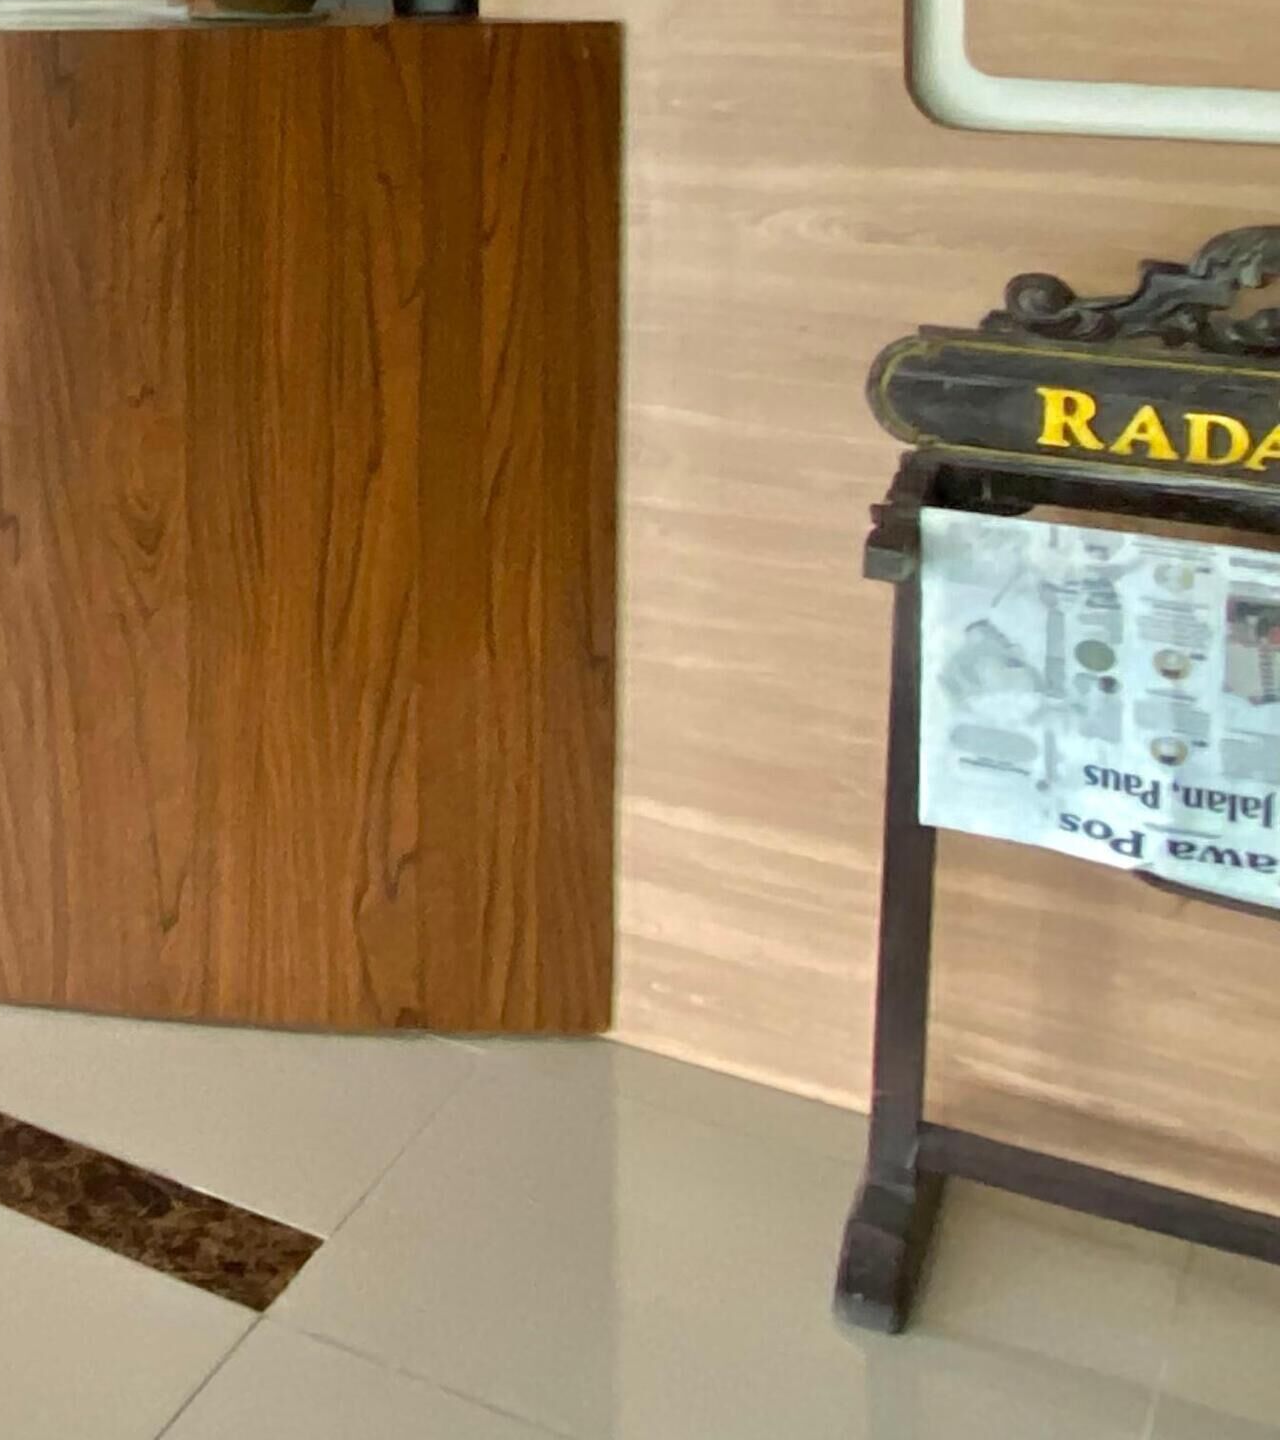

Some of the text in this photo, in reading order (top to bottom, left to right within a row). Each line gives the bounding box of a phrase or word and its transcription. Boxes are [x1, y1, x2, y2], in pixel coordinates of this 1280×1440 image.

[1083, 764, 1161, 809] Paus
[1172, 781, 1276, 828] Jalan,
[1059, 812, 1146, 859] Pos
